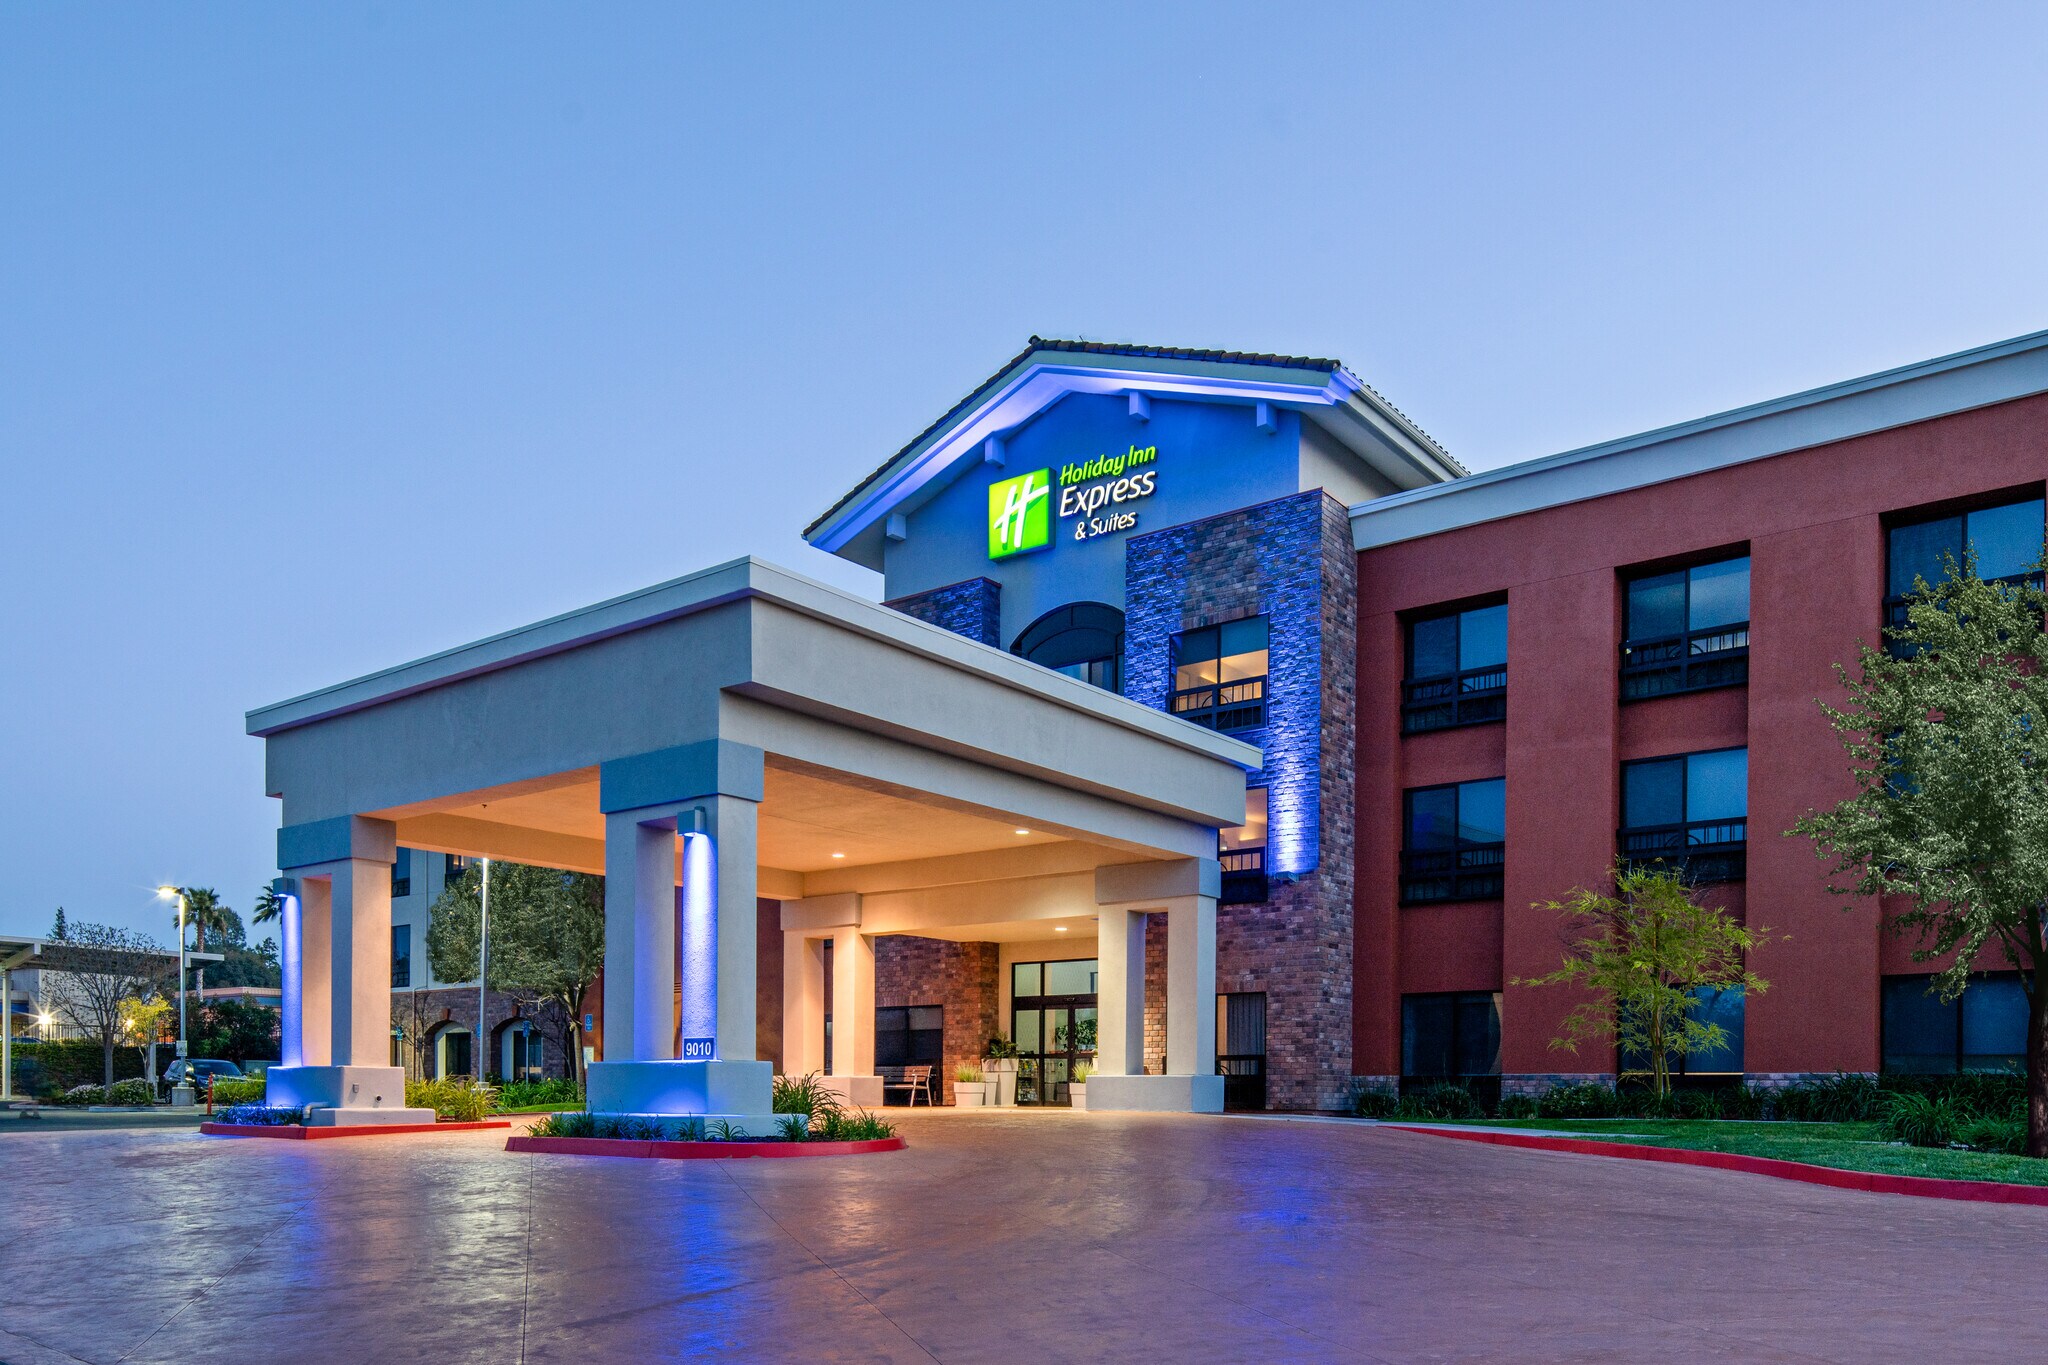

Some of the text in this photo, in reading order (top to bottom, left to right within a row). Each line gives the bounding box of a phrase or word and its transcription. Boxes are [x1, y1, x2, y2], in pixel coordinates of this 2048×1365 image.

[1059, 445, 1156, 486] Holiday Inn
[1059, 471, 1156, 518] Express
[1074, 512, 1137, 541] & Suites
[686, 1042, 712, 1056] 9010
